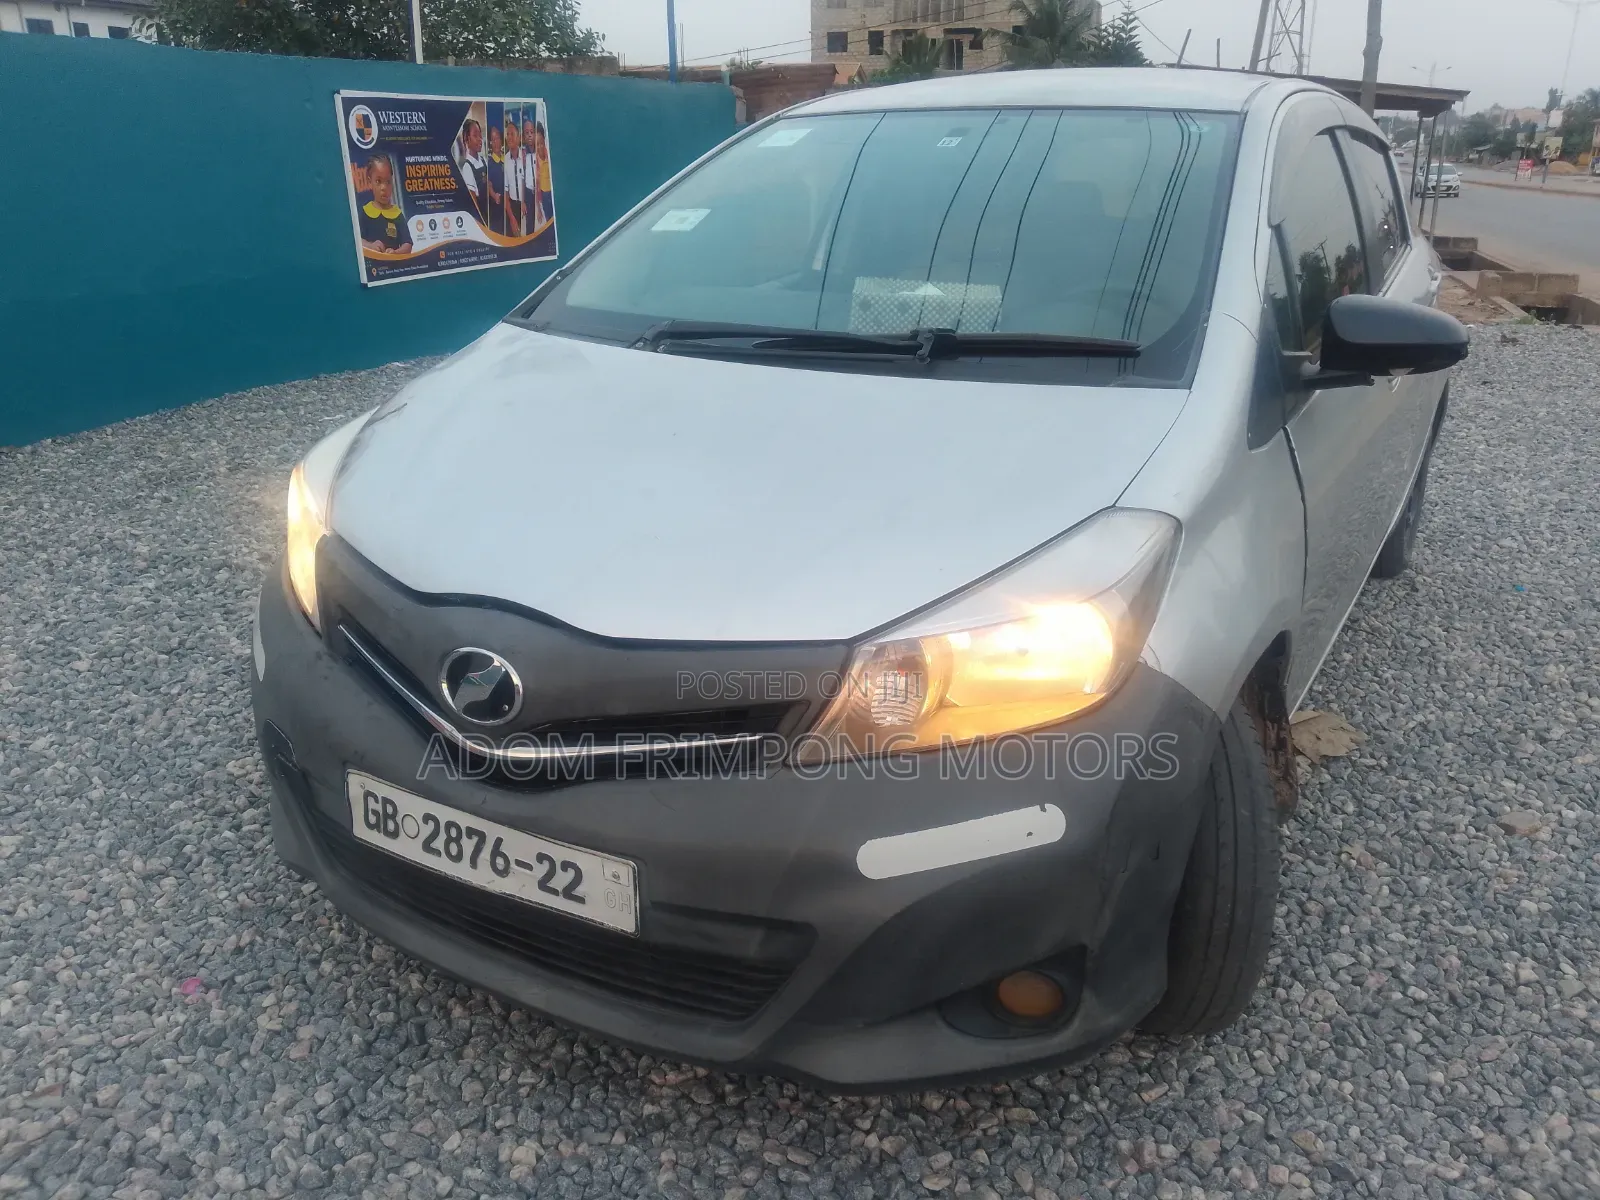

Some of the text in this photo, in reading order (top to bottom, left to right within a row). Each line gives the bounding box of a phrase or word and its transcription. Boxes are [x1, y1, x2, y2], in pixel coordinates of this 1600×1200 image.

[378, 111, 426, 124] WESTERN
[405, 164, 451, 177] INSPIRING
[405, 177, 459, 192] GREATNESS.
[363, 789, 586, 905] GB 2876-22
[604, 887, 632, 914] GH
